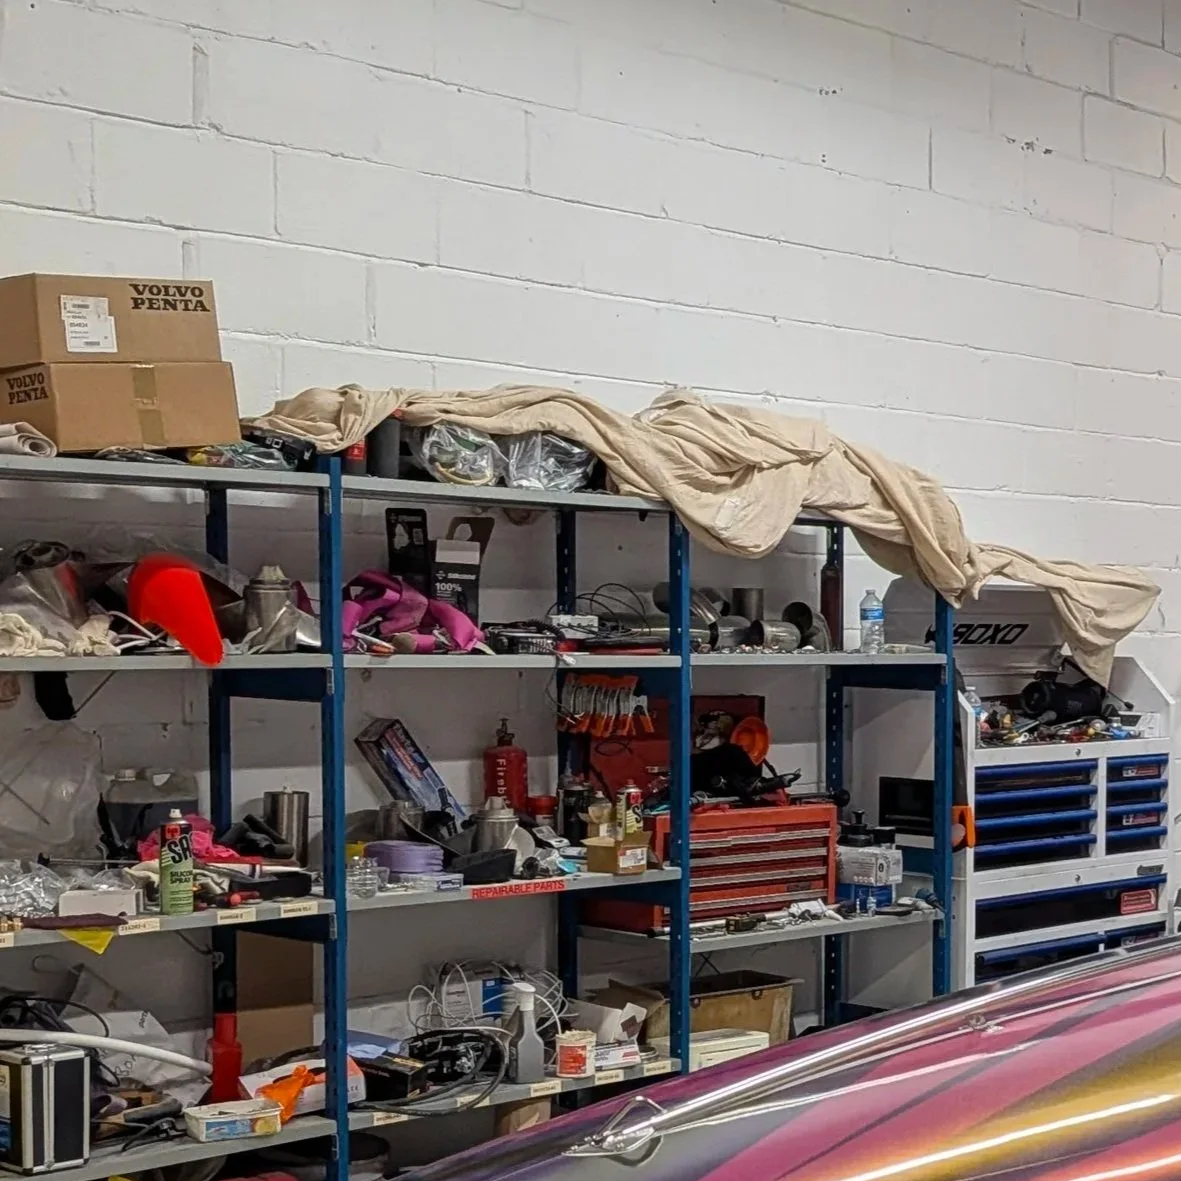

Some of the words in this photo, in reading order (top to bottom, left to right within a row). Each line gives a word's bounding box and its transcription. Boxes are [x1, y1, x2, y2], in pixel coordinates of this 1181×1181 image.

[129, 283, 204, 298] VOLVO
[131, 297, 210, 312] PENTA
[6, 372, 45, 391] VOLVO
[8, 387, 49, 405] PENTA
[435, 582, 462, 592] 100%
[472, 883, 531, 898] REPAIRABLE
[534, 880, 565, 893] PARTS
